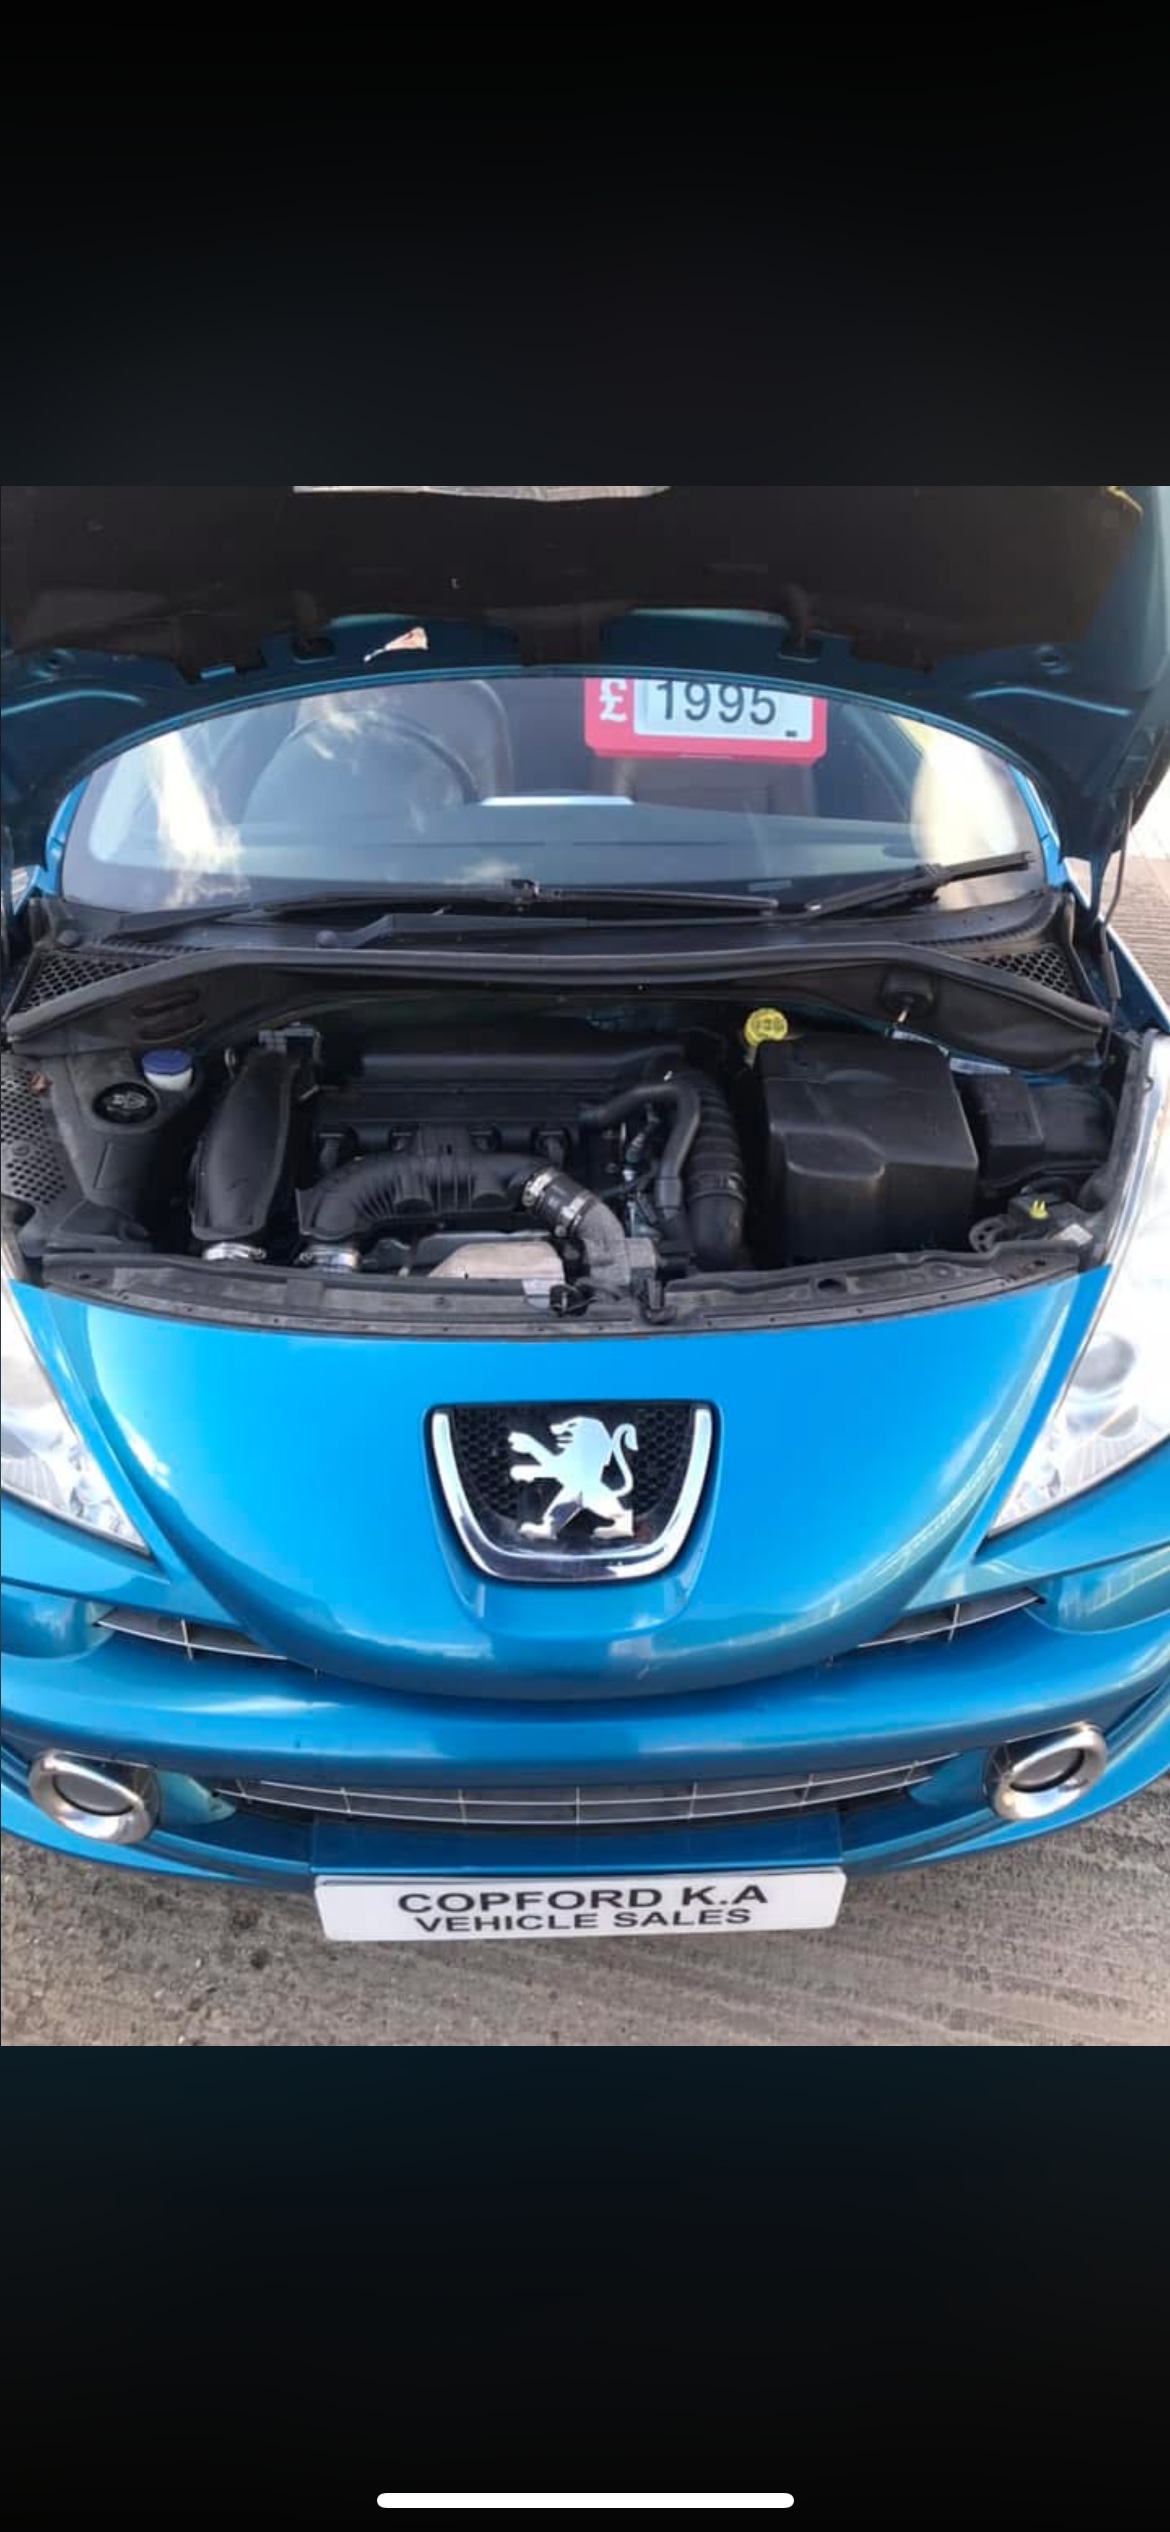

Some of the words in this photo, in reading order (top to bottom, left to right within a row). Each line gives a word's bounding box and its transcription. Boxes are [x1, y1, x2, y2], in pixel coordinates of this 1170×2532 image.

[599, 678, 628, 722] £
[657, 681, 776, 725] 1995
[398, 1888, 662, 1914] COPFORD
[682, 1885, 768, 1906] K.A
[415, 1914, 598, 1932] VEHICLE
[613, 1908, 751, 1928] SALES
